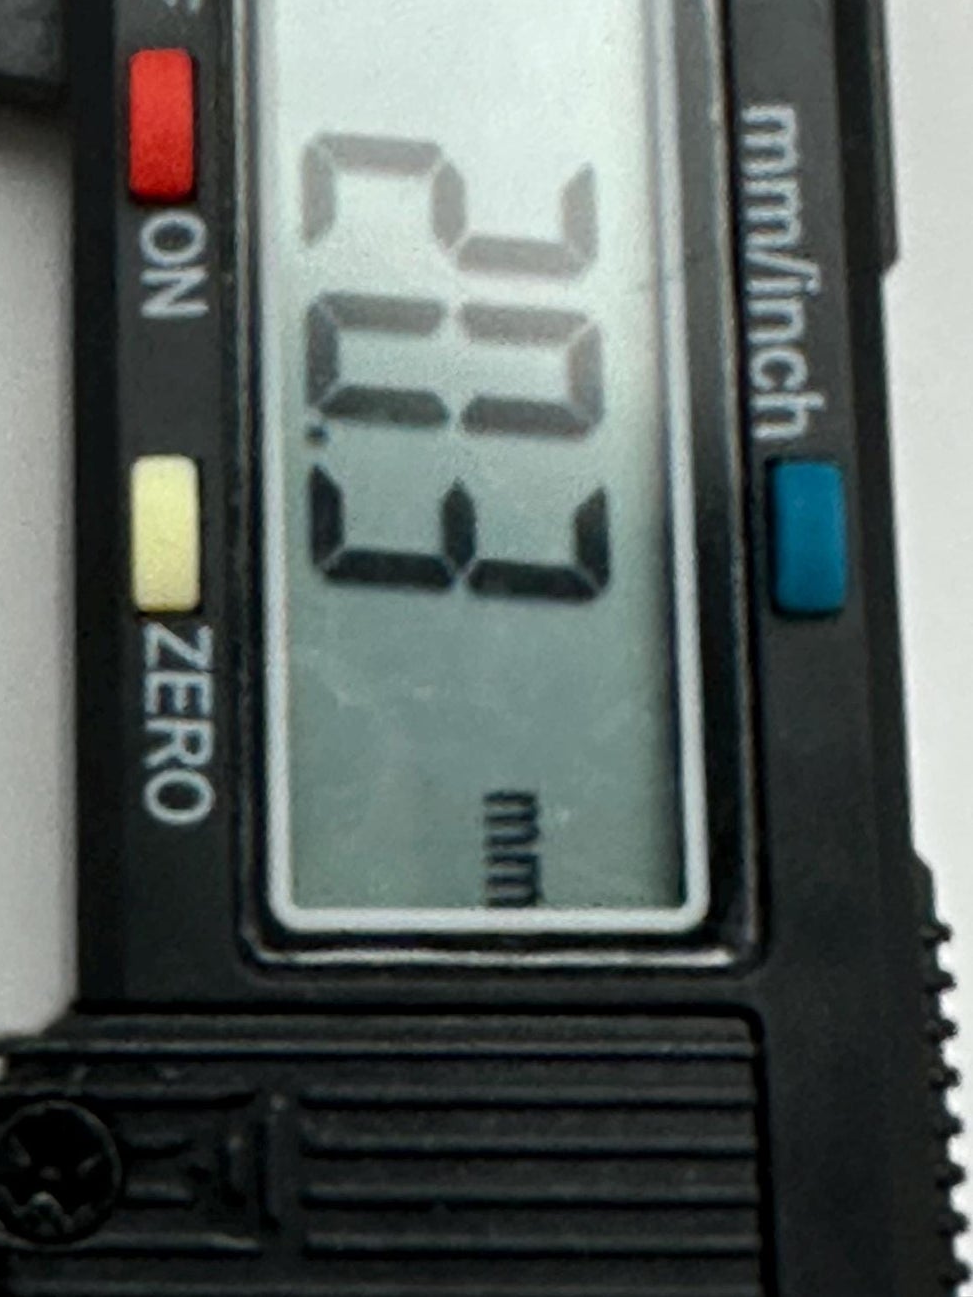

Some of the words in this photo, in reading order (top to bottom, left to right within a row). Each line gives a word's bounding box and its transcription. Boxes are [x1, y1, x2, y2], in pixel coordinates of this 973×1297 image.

[138, 209, 206, 318] ON
[739, 104, 823, 441] mm/inch
[302, 131, 611, 606] 20.3
[482, 791, 546, 908] mm
[142, 622, 212, 825] ZERO
